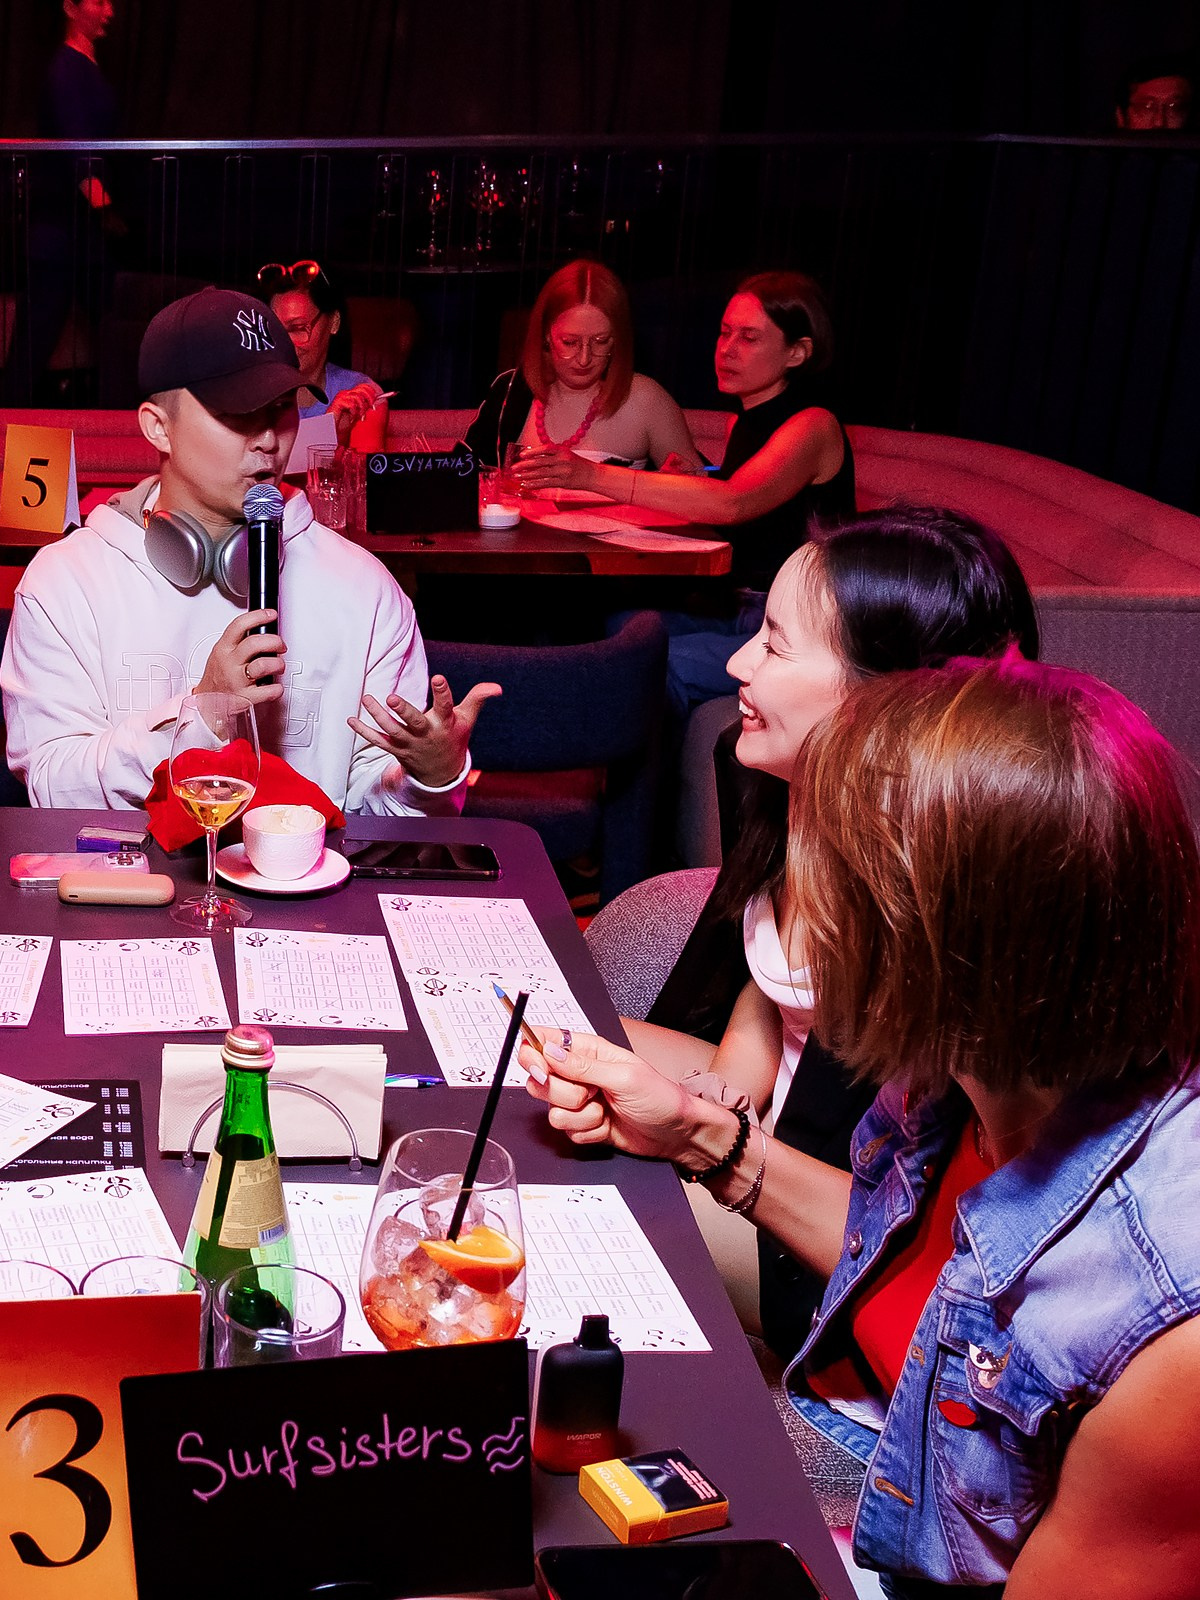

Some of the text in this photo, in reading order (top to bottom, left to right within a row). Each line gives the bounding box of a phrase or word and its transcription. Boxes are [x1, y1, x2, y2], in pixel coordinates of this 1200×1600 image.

[232, 308, 276, 351] NY
[21, 457, 48, 508] 5
[4, 1392, 114, 1568] 3
[176, 1413, 473, 1501] Surfsisters
[594, 1466, 633, 1507] WINSTON
